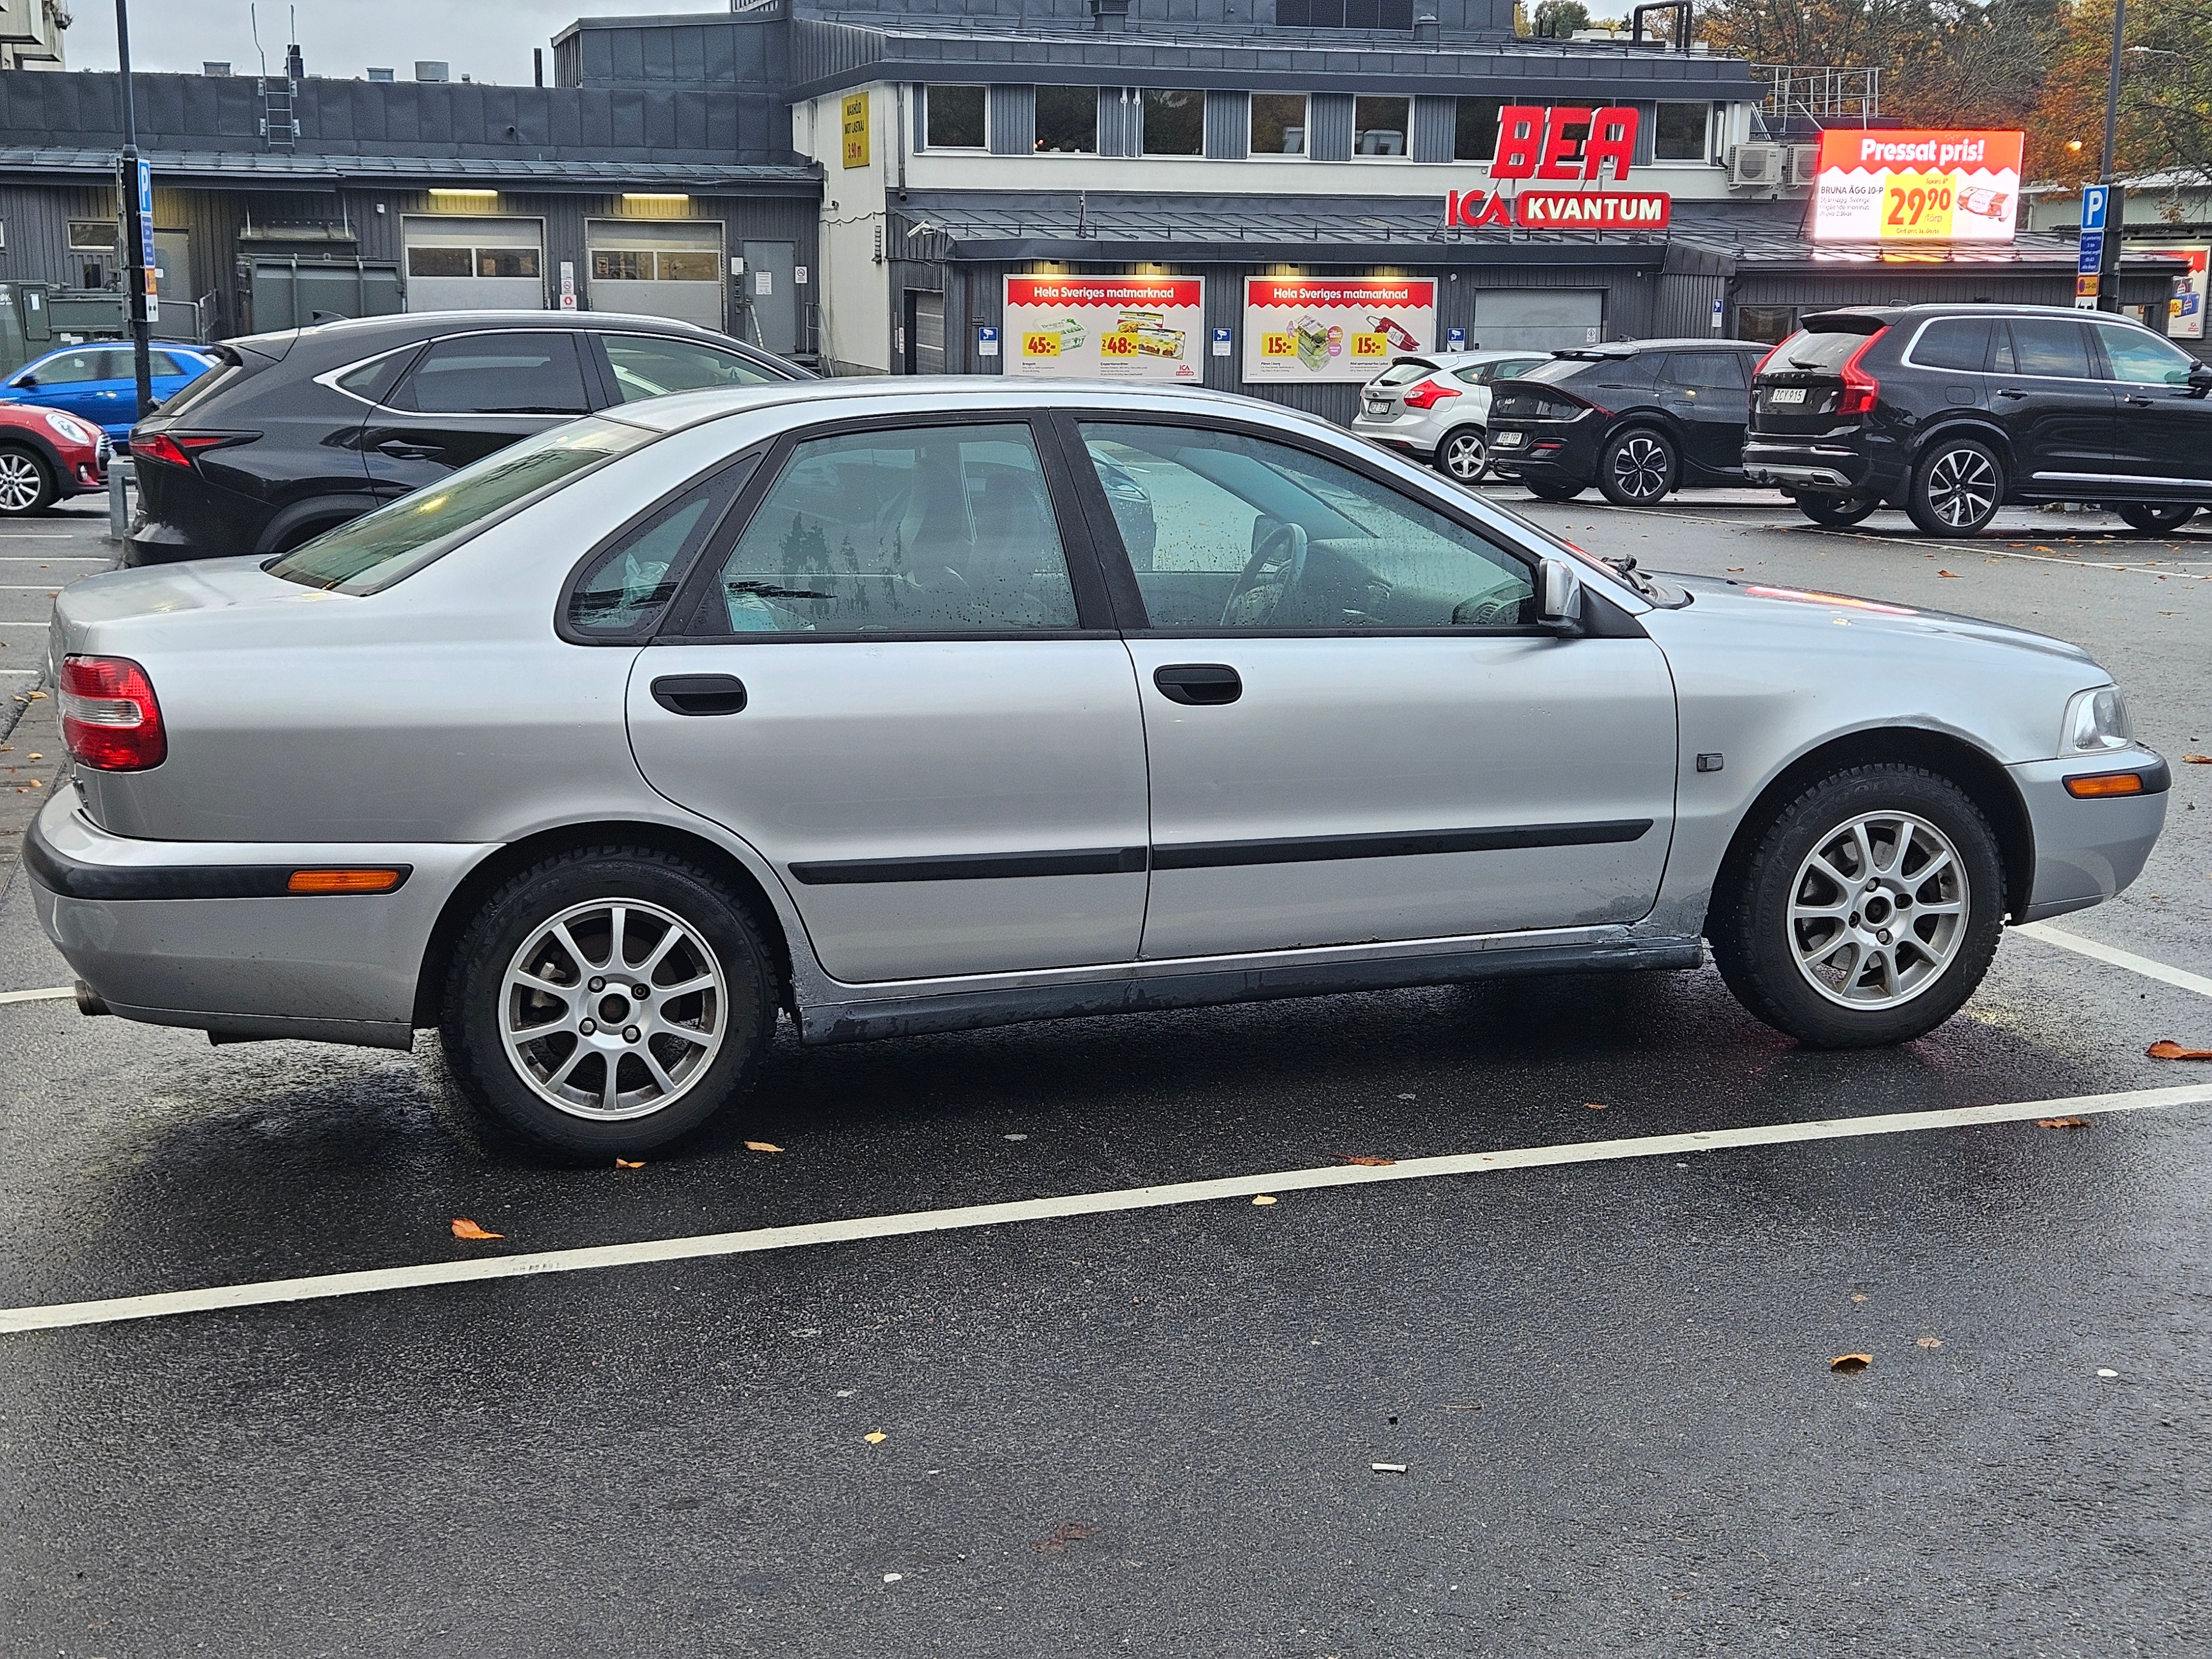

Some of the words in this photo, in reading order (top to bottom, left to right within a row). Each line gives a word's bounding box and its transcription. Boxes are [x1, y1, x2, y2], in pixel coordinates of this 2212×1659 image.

[1487, 106, 1640, 181] BEA
[1861, 138, 1937, 160] Pressat
[1939, 138, 1985, 166] pris!
[140, 166, 149, 208] P
[1849, 185, 1866, 194] ÄGG
[1445, 189, 1513, 227] ICA
[1527, 197, 1662, 220] KVANTUM
[2087, 191, 2103, 225] P
[1034, 286, 1058, 298] Hela
[1061, 286, 1105, 300] Sveriges
[1107, 287, 1174, 298] matmarknad
[1274, 288, 1297, 299] Hela
[1300, 288, 1341, 300] Sveriges
[1343, 288, 1408, 299] matmarknad
[1028, 336, 1056, 353] 45:-
[1102, 339, 1107, 347] 2
[1108, 337, 1137, 354] 48:-
[1268, 337, 1292, 353] 15:-
[1357, 337, 1381, 353] 15:-
[1775, 390, 1790, 401] ZCY
[1788, 390, 1802, 401] 915
